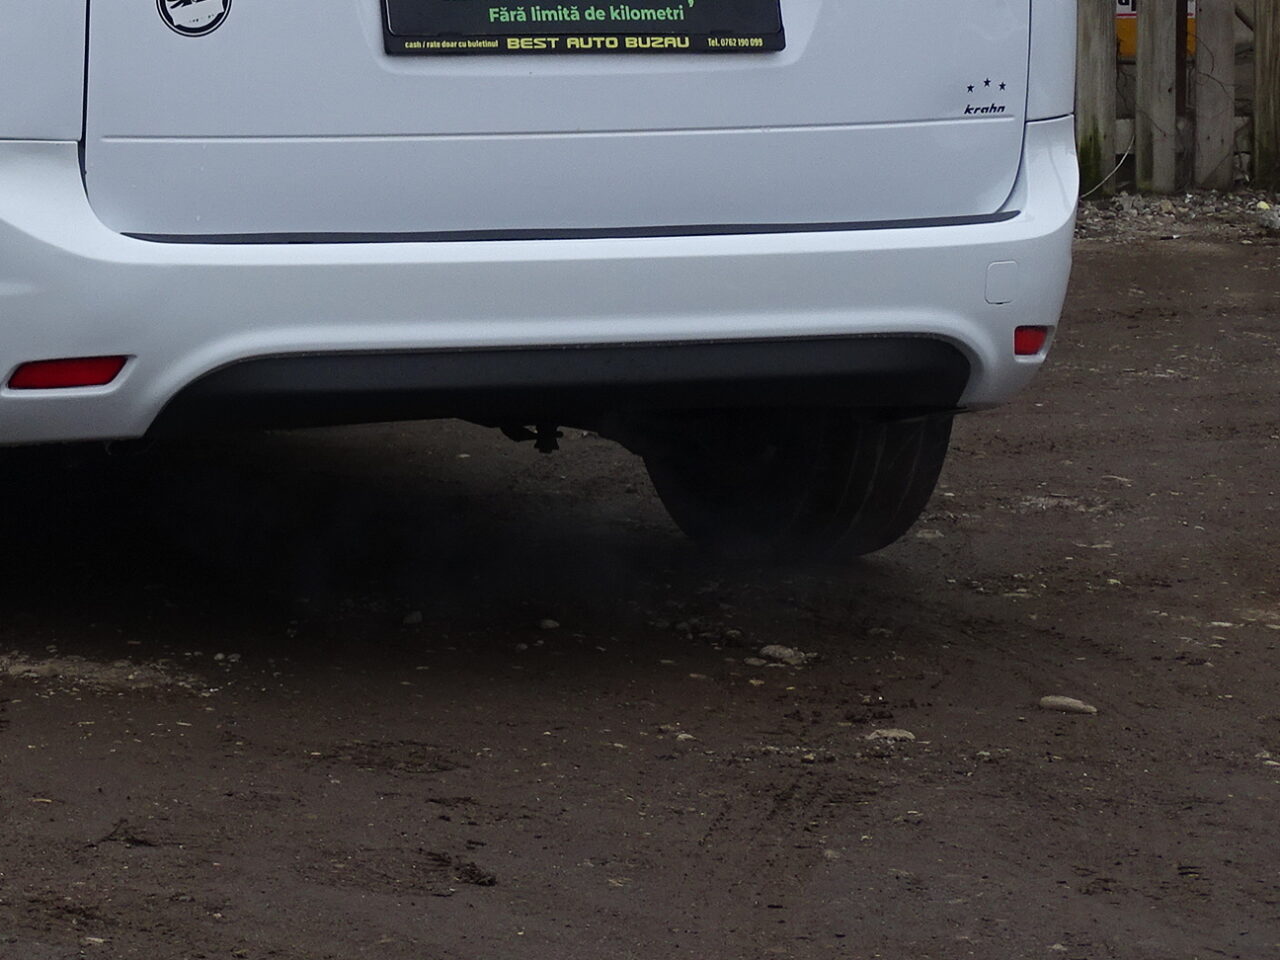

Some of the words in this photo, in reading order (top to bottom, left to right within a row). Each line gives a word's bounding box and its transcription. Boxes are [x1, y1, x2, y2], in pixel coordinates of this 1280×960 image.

[489, 6, 527, 22] Fără
[531, 5, 580, 21] limită
[584, 5, 606, 21] de
[610, 4, 684, 20] kilometri
[405, 41, 421, 49] cash
[467, 40, 499, 48] buletinul
[507, 38, 559, 49] BEST
[567, 37, 618, 48] AUTO
[625, 37, 689, 48] BUZAU
[964, 103, 1006, 115] krahn
